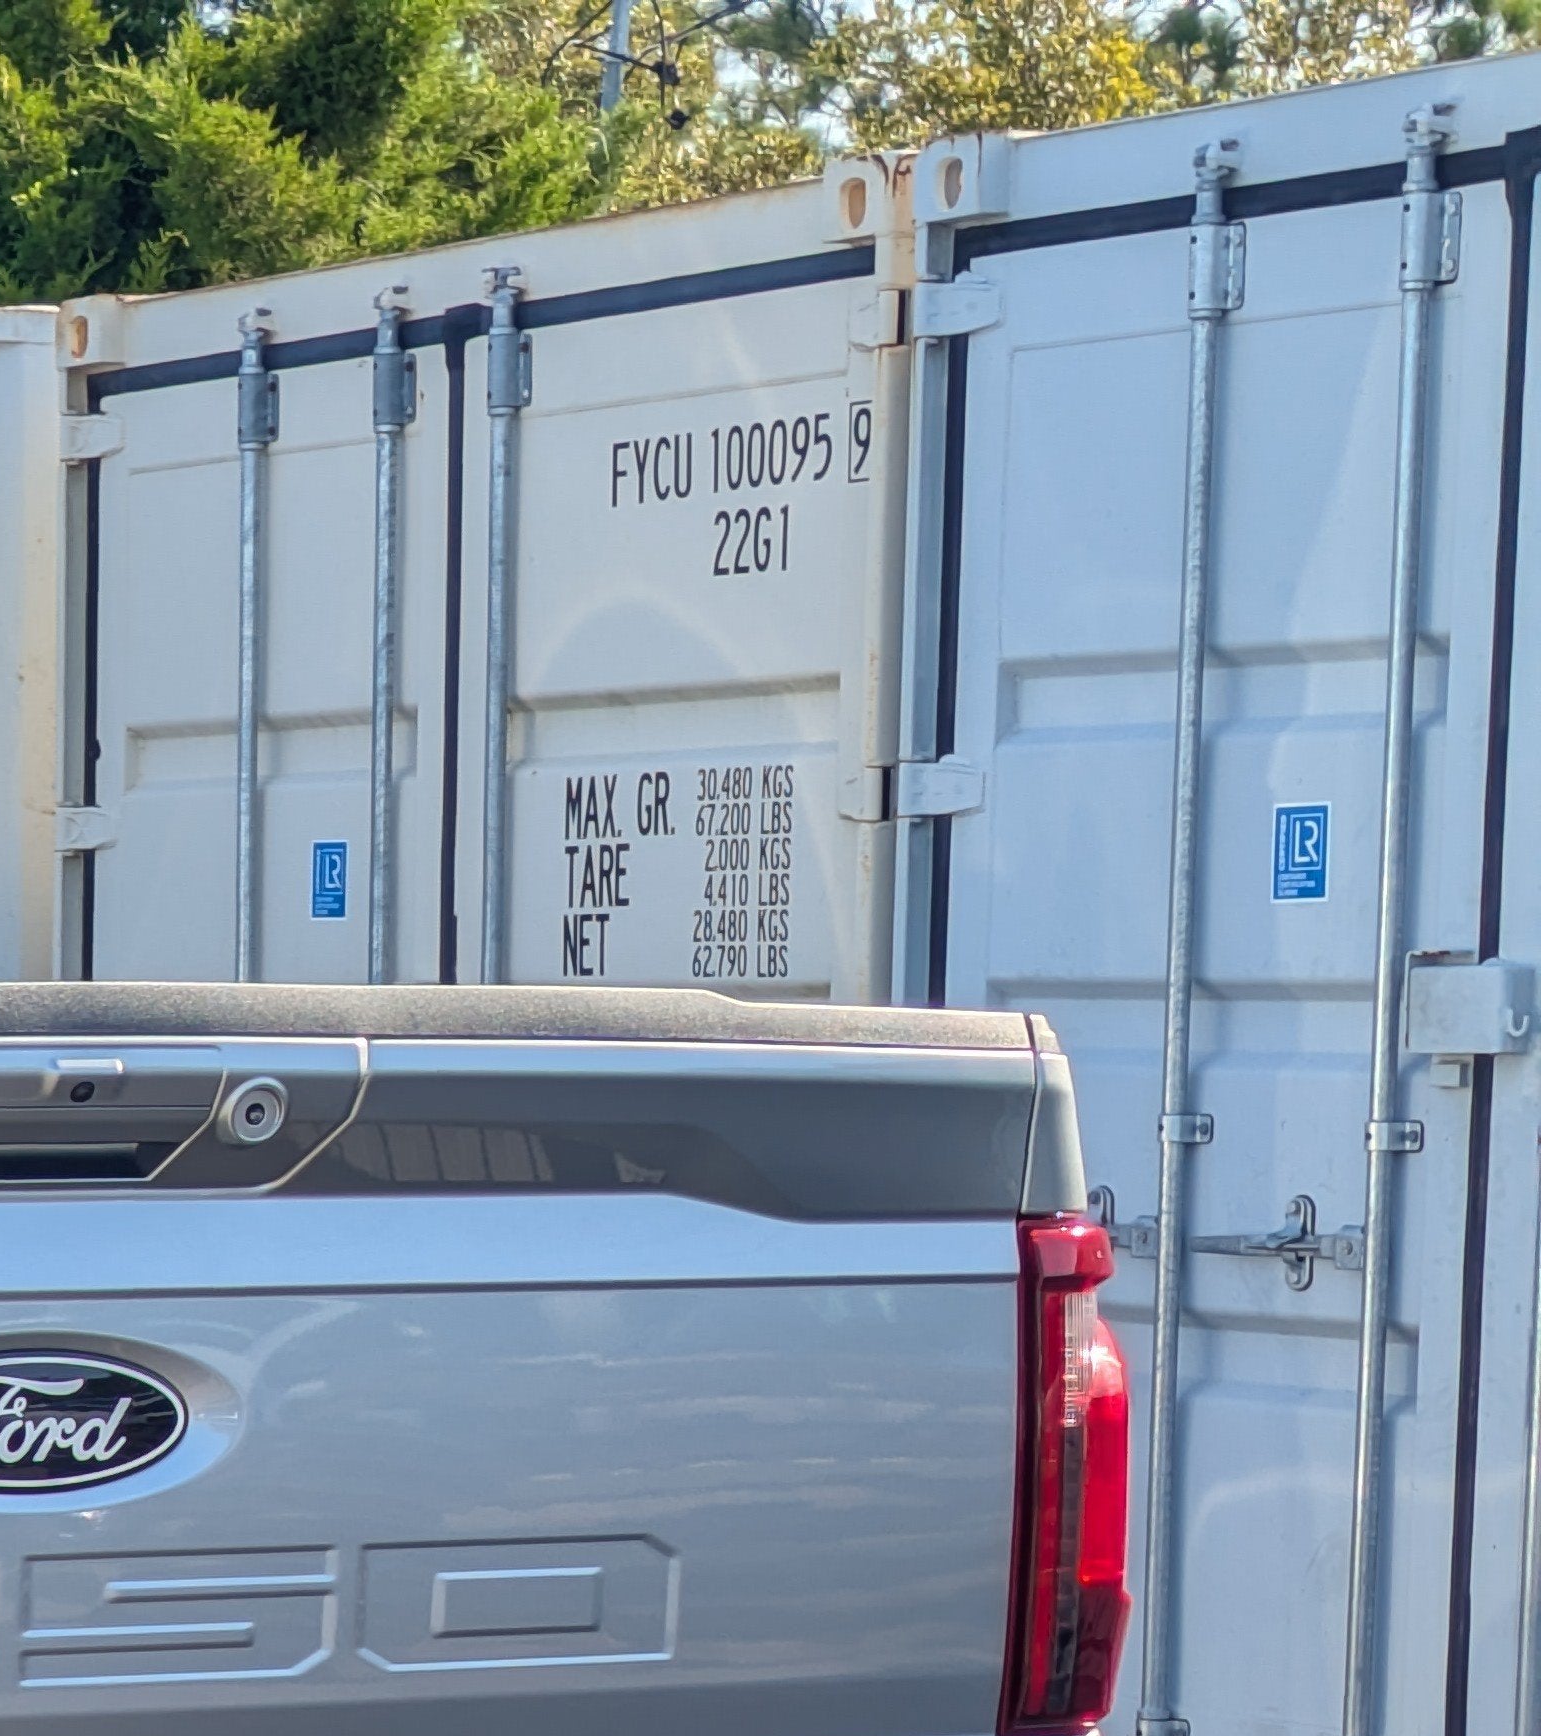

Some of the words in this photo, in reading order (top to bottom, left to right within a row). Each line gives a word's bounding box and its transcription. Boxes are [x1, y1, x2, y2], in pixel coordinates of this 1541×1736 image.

[611, 432, 693, 508] FYCU
[711, 412, 833, 494] 100095
[853, 407, 872, 475] 9
[713, 503, 789, 576] 22G1
[564, 773, 623, 840] MAX.
[637, 771, 676, 836] GR.
[696, 766, 753, 801] 30.480
[761, 765, 794, 799] KGS
[695, 802, 751, 837] 67.200
[760, 801, 793, 835] LBS
[564, 843, 630, 909] TARE
[704, 838, 750, 872] 2.000
[758, 837, 792, 871] KGS
[704, 873, 749, 907] 4.410
[758, 873, 791, 907] LBS
[563, 913, 610, 977] NET
[692, 909, 748, 943] 28.480
[756, 909, 789, 942] KGS
[691, 944, 748, 978] 62.790
[756, 944, 789, 978] LBS
